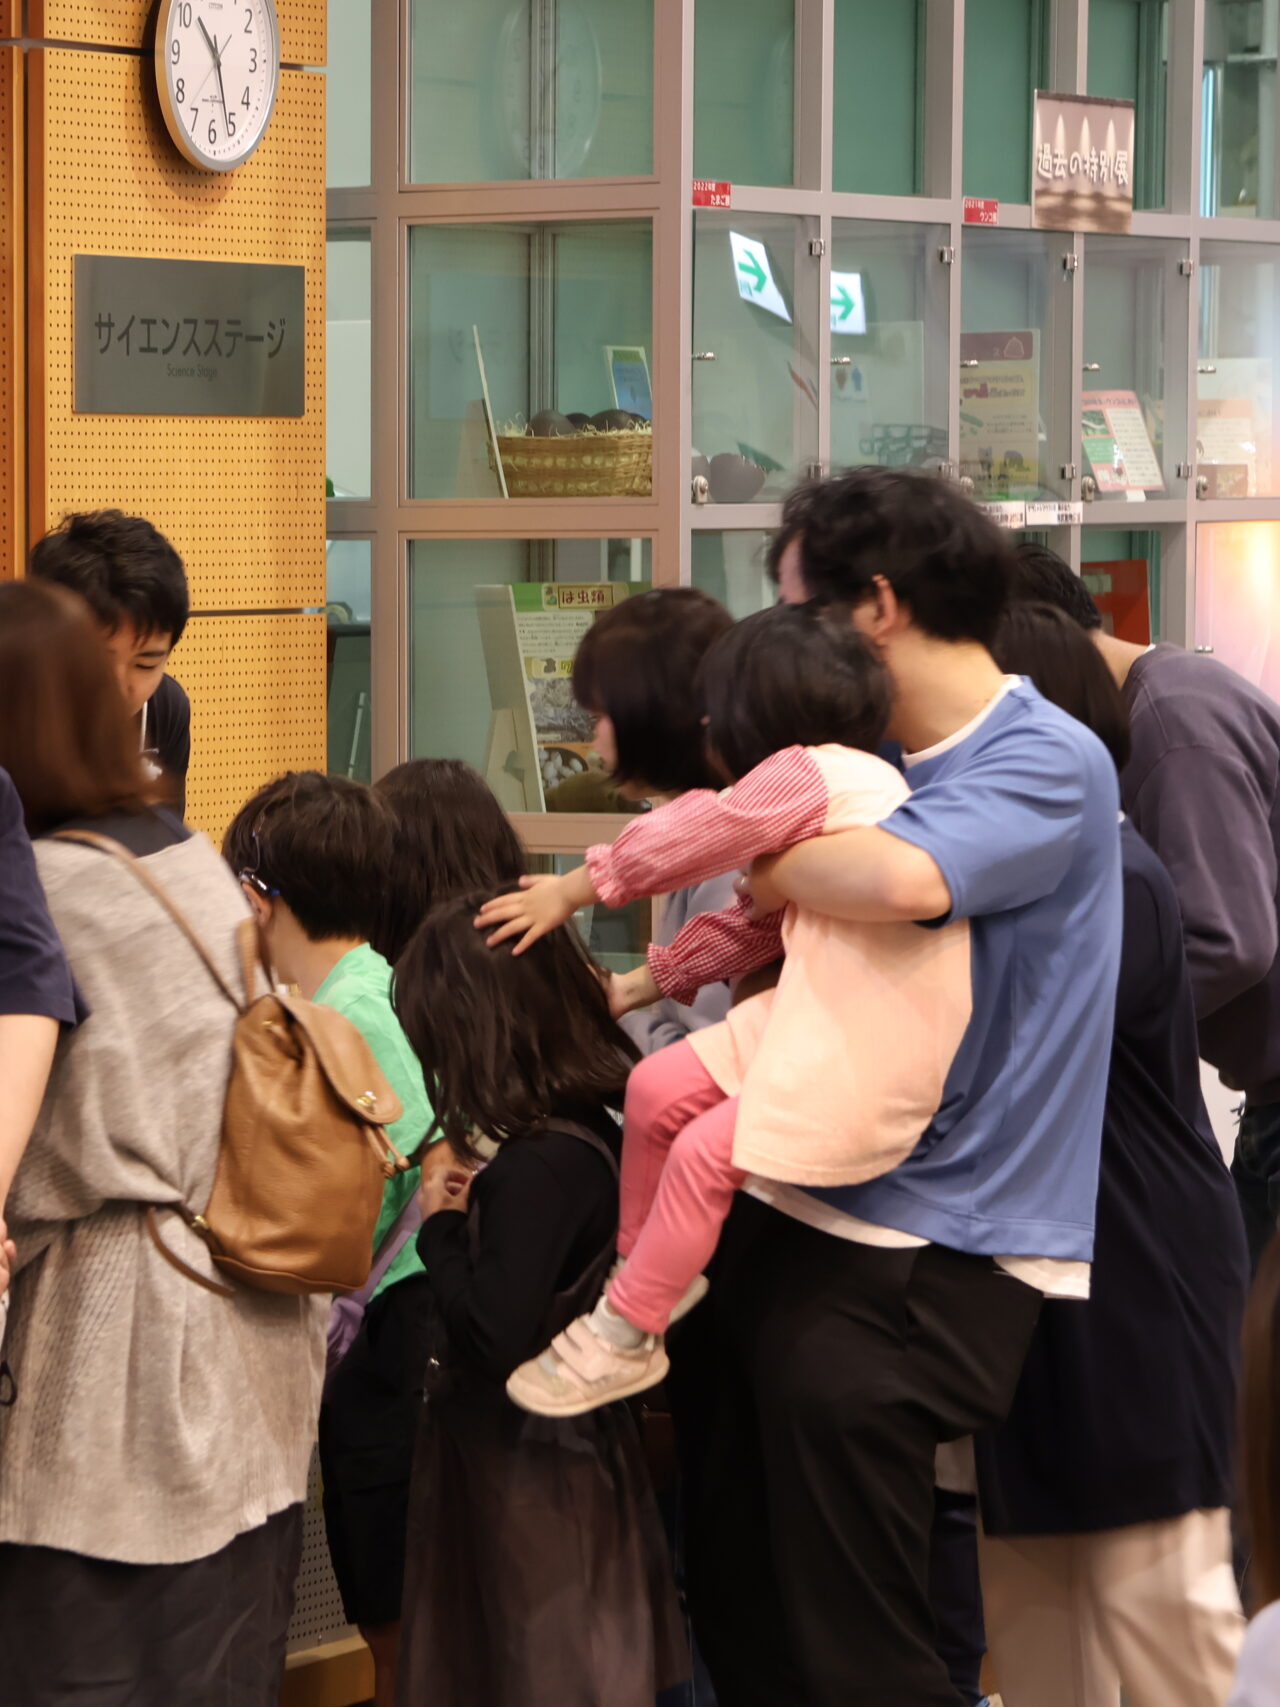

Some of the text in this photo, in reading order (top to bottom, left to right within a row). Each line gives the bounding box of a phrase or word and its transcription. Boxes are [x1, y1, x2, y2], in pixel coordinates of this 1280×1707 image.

[178, 2, 192, 28] 10
[244, 8, 253, 34] 2
[171, 39, 180, 65] 9
[248, 48, 258, 73] 3
[176, 78, 185, 104] 8
[241, 86, 251, 111] 4
[190, 107, 199, 133] 7
[208, 119, 217, 144] 6
[227, 112, 236, 137] 5
[1038, 142, 1128, 185] 過去の特別展
[94, 312, 286, 359] サイエンスステージ
[167, 363, 218, 381] Science Stage
